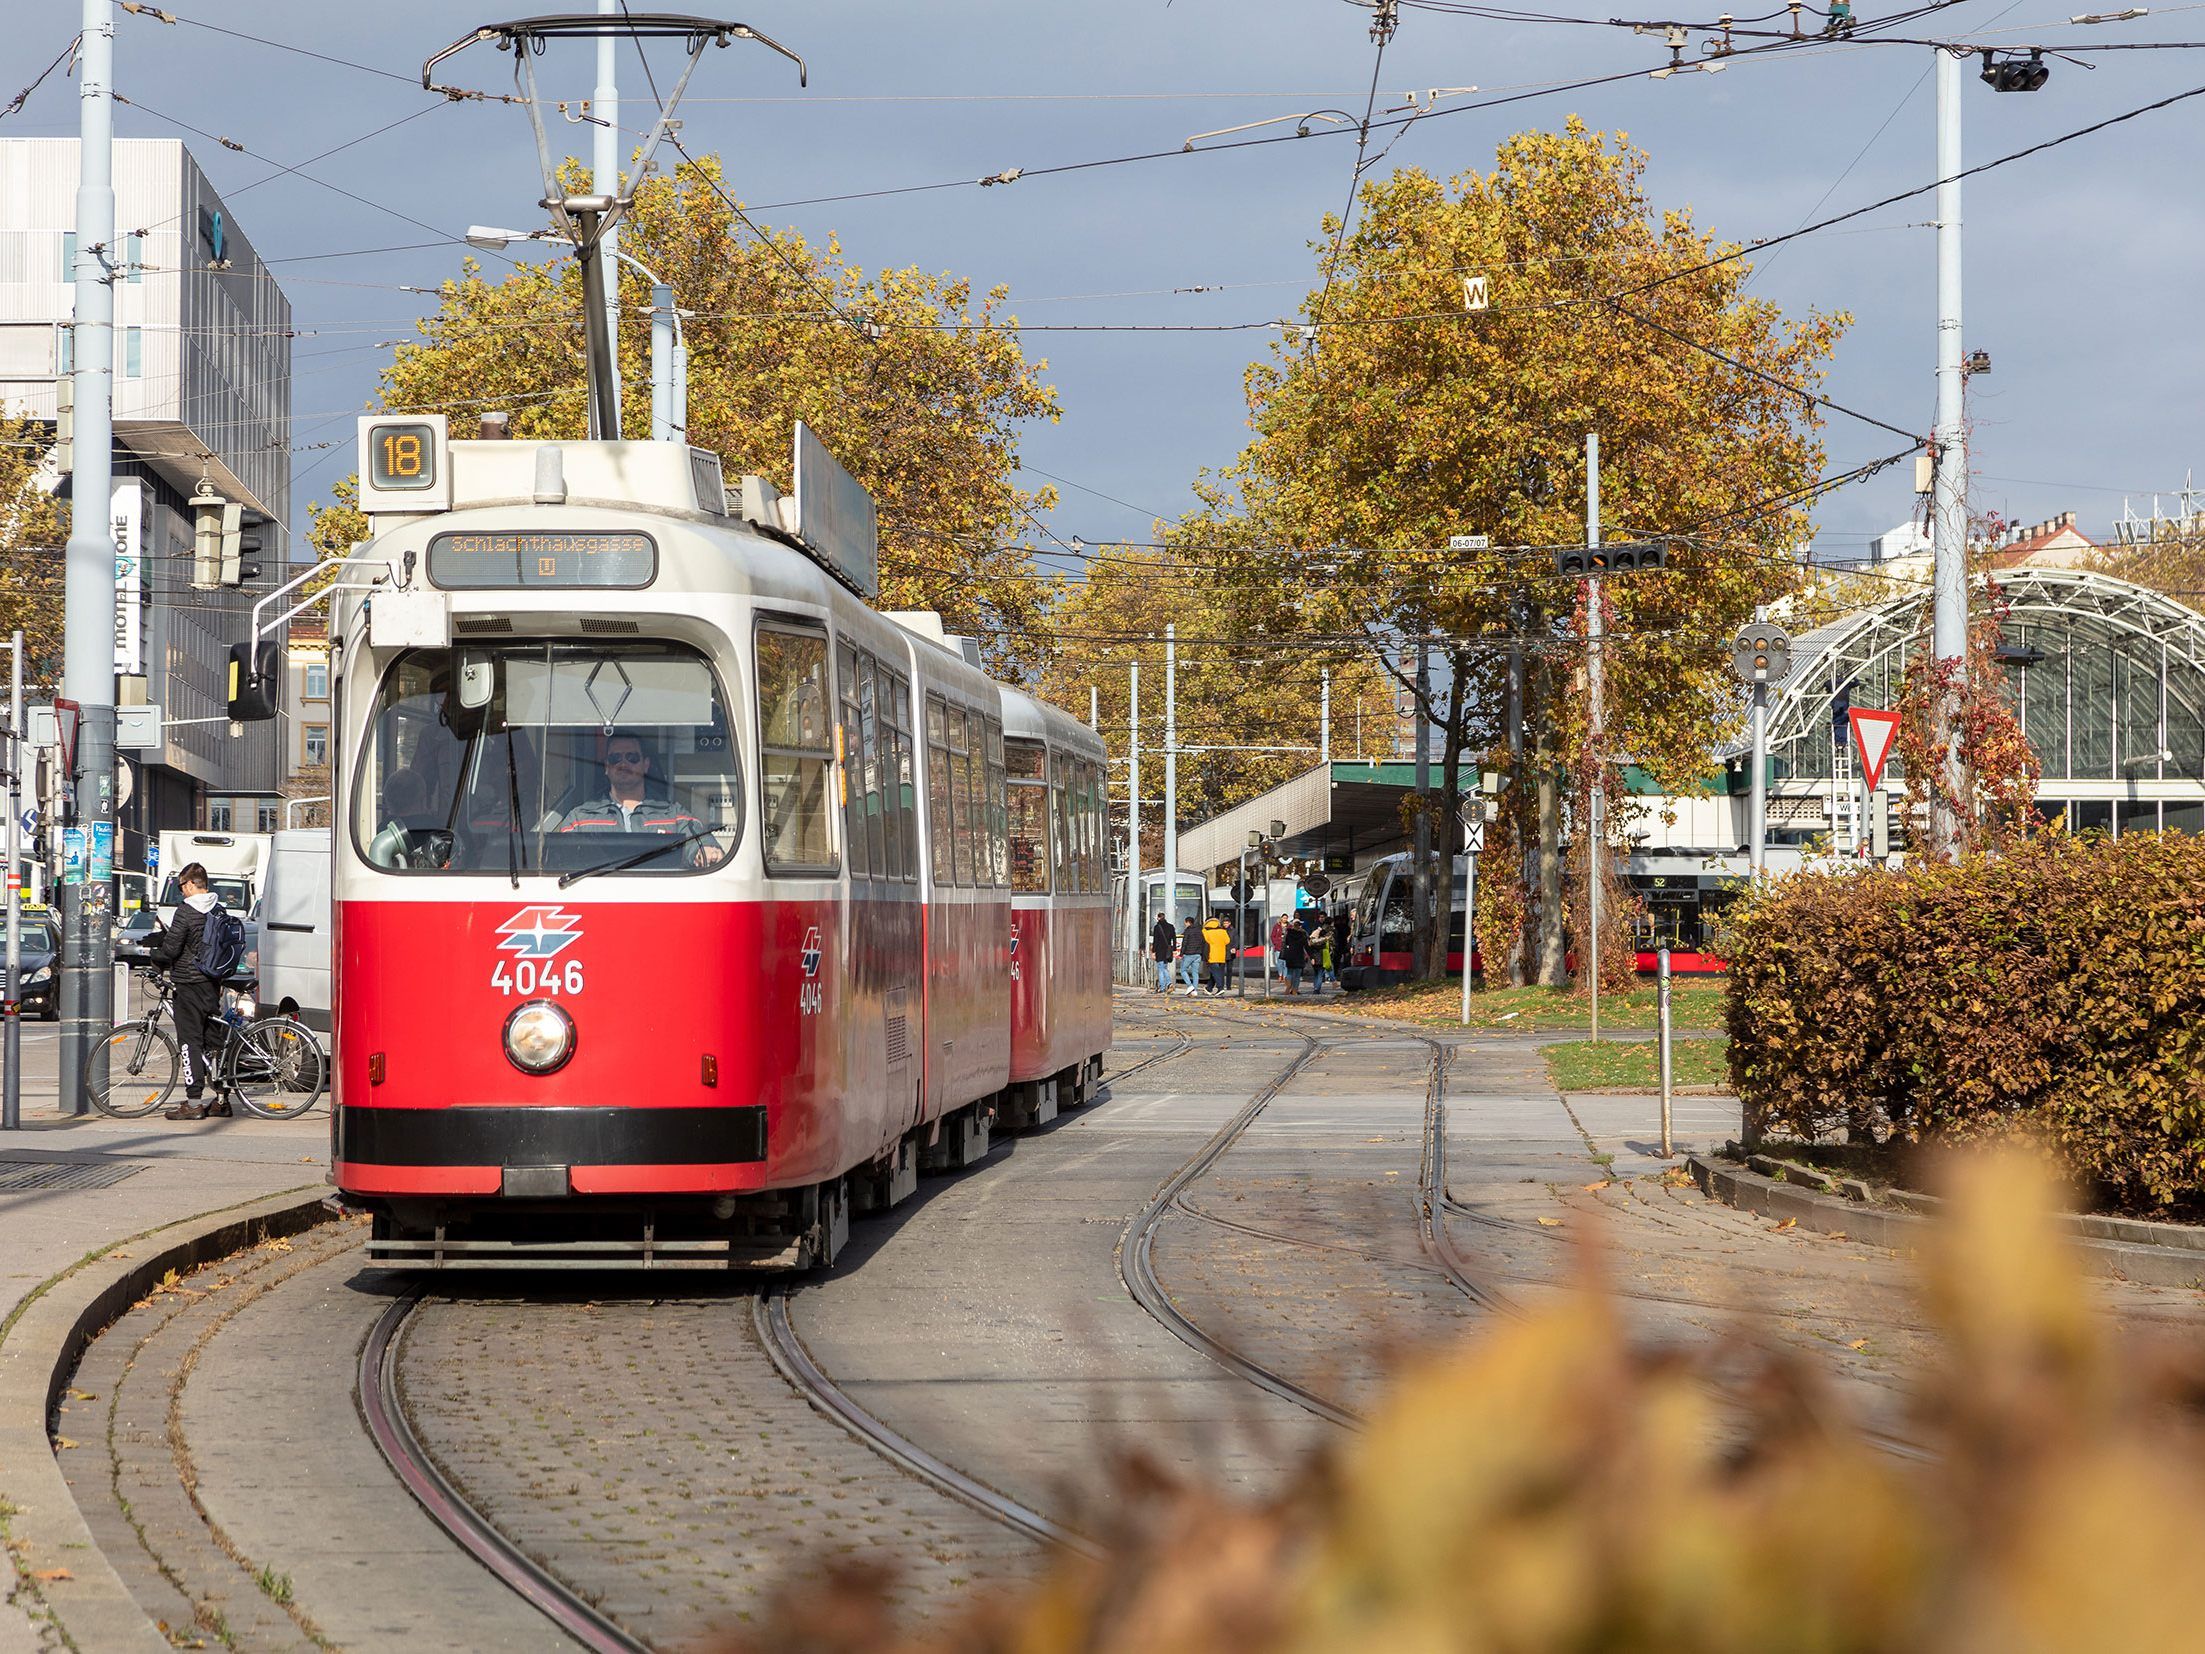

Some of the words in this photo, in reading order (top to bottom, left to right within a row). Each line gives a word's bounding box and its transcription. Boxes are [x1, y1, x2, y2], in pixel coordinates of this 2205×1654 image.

[1465, 282, 1485, 304] W
[384, 435, 421, 476] 18
[452, 536, 644, 555] Schlachthausgasse
[1654, 877, 1665, 887] 52
[491, 960, 584, 996] 4046
[800, 982, 822, 1015] 4046
[181, 1043, 194, 1085] adidas
